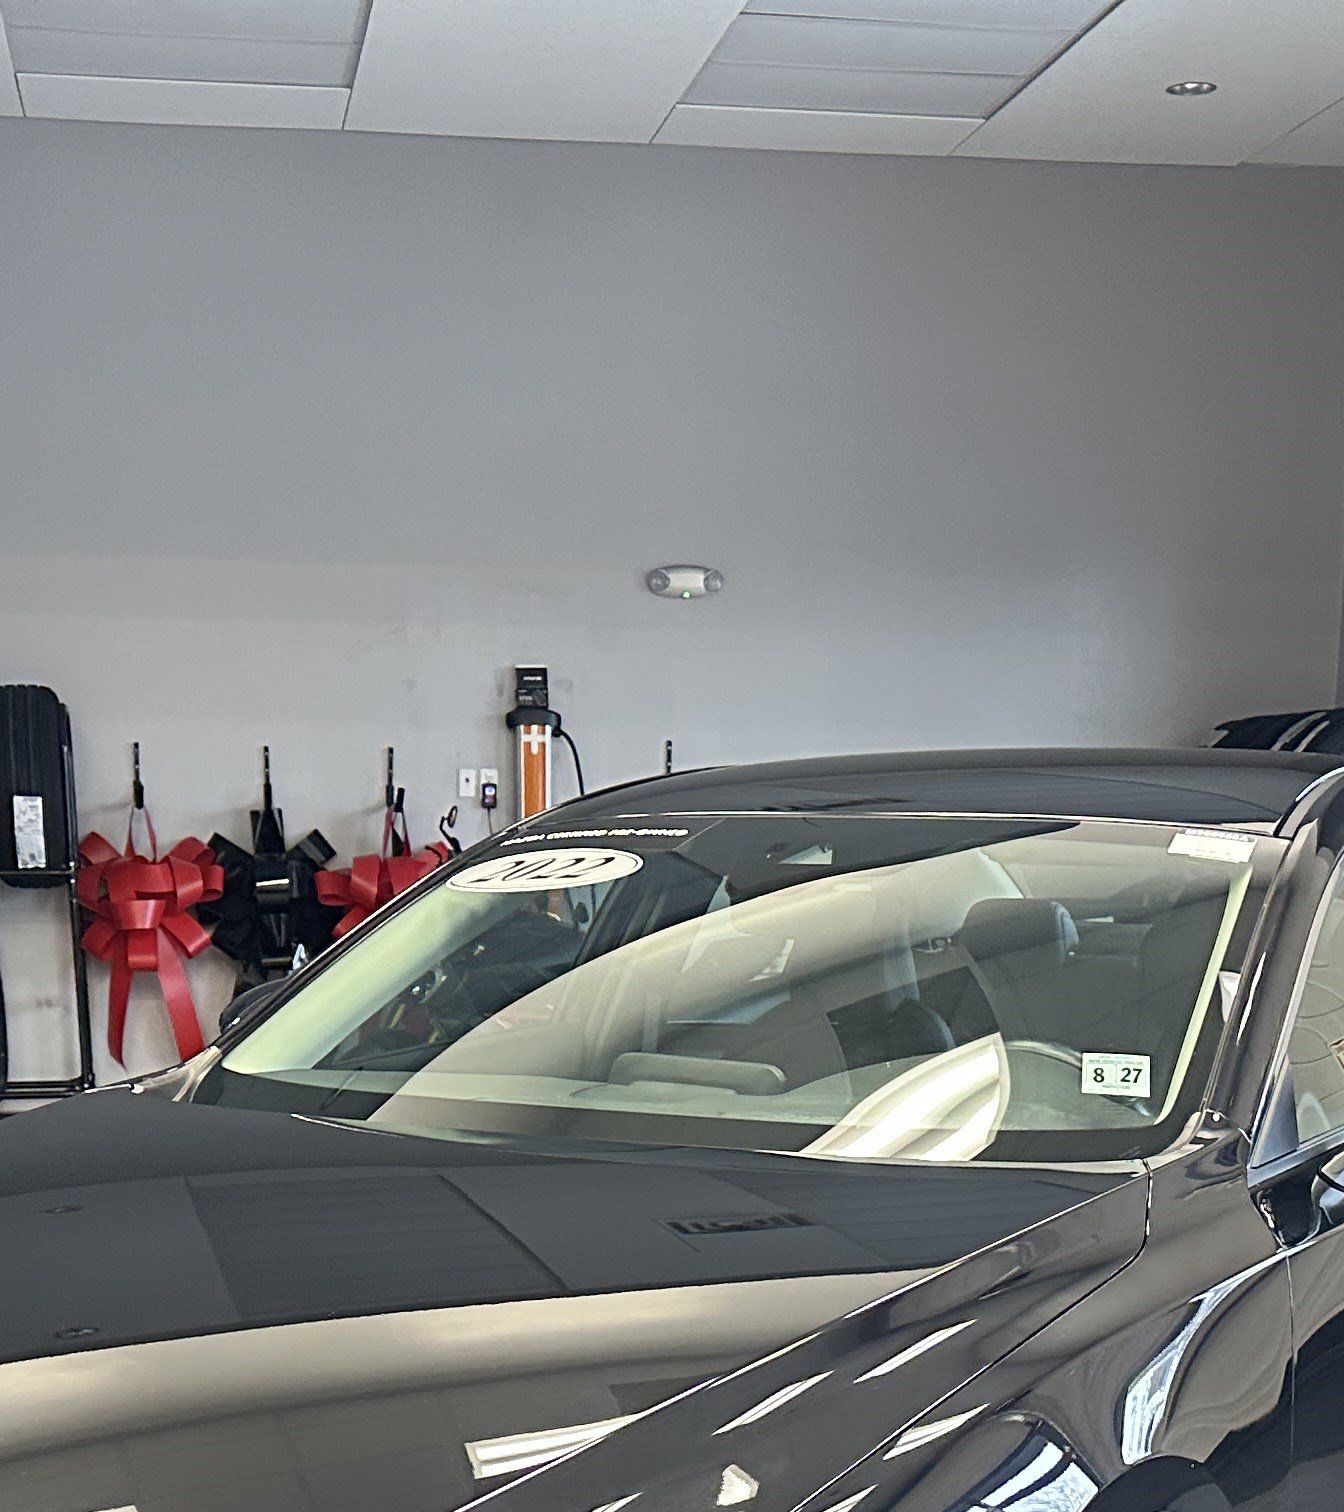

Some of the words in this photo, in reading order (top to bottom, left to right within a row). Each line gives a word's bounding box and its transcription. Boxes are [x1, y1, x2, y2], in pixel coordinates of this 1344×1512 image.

[468, 856, 616, 883] 2022
[1093, 1067, 1105, 1083] 8
[1120, 1067, 1143, 1083] 27
